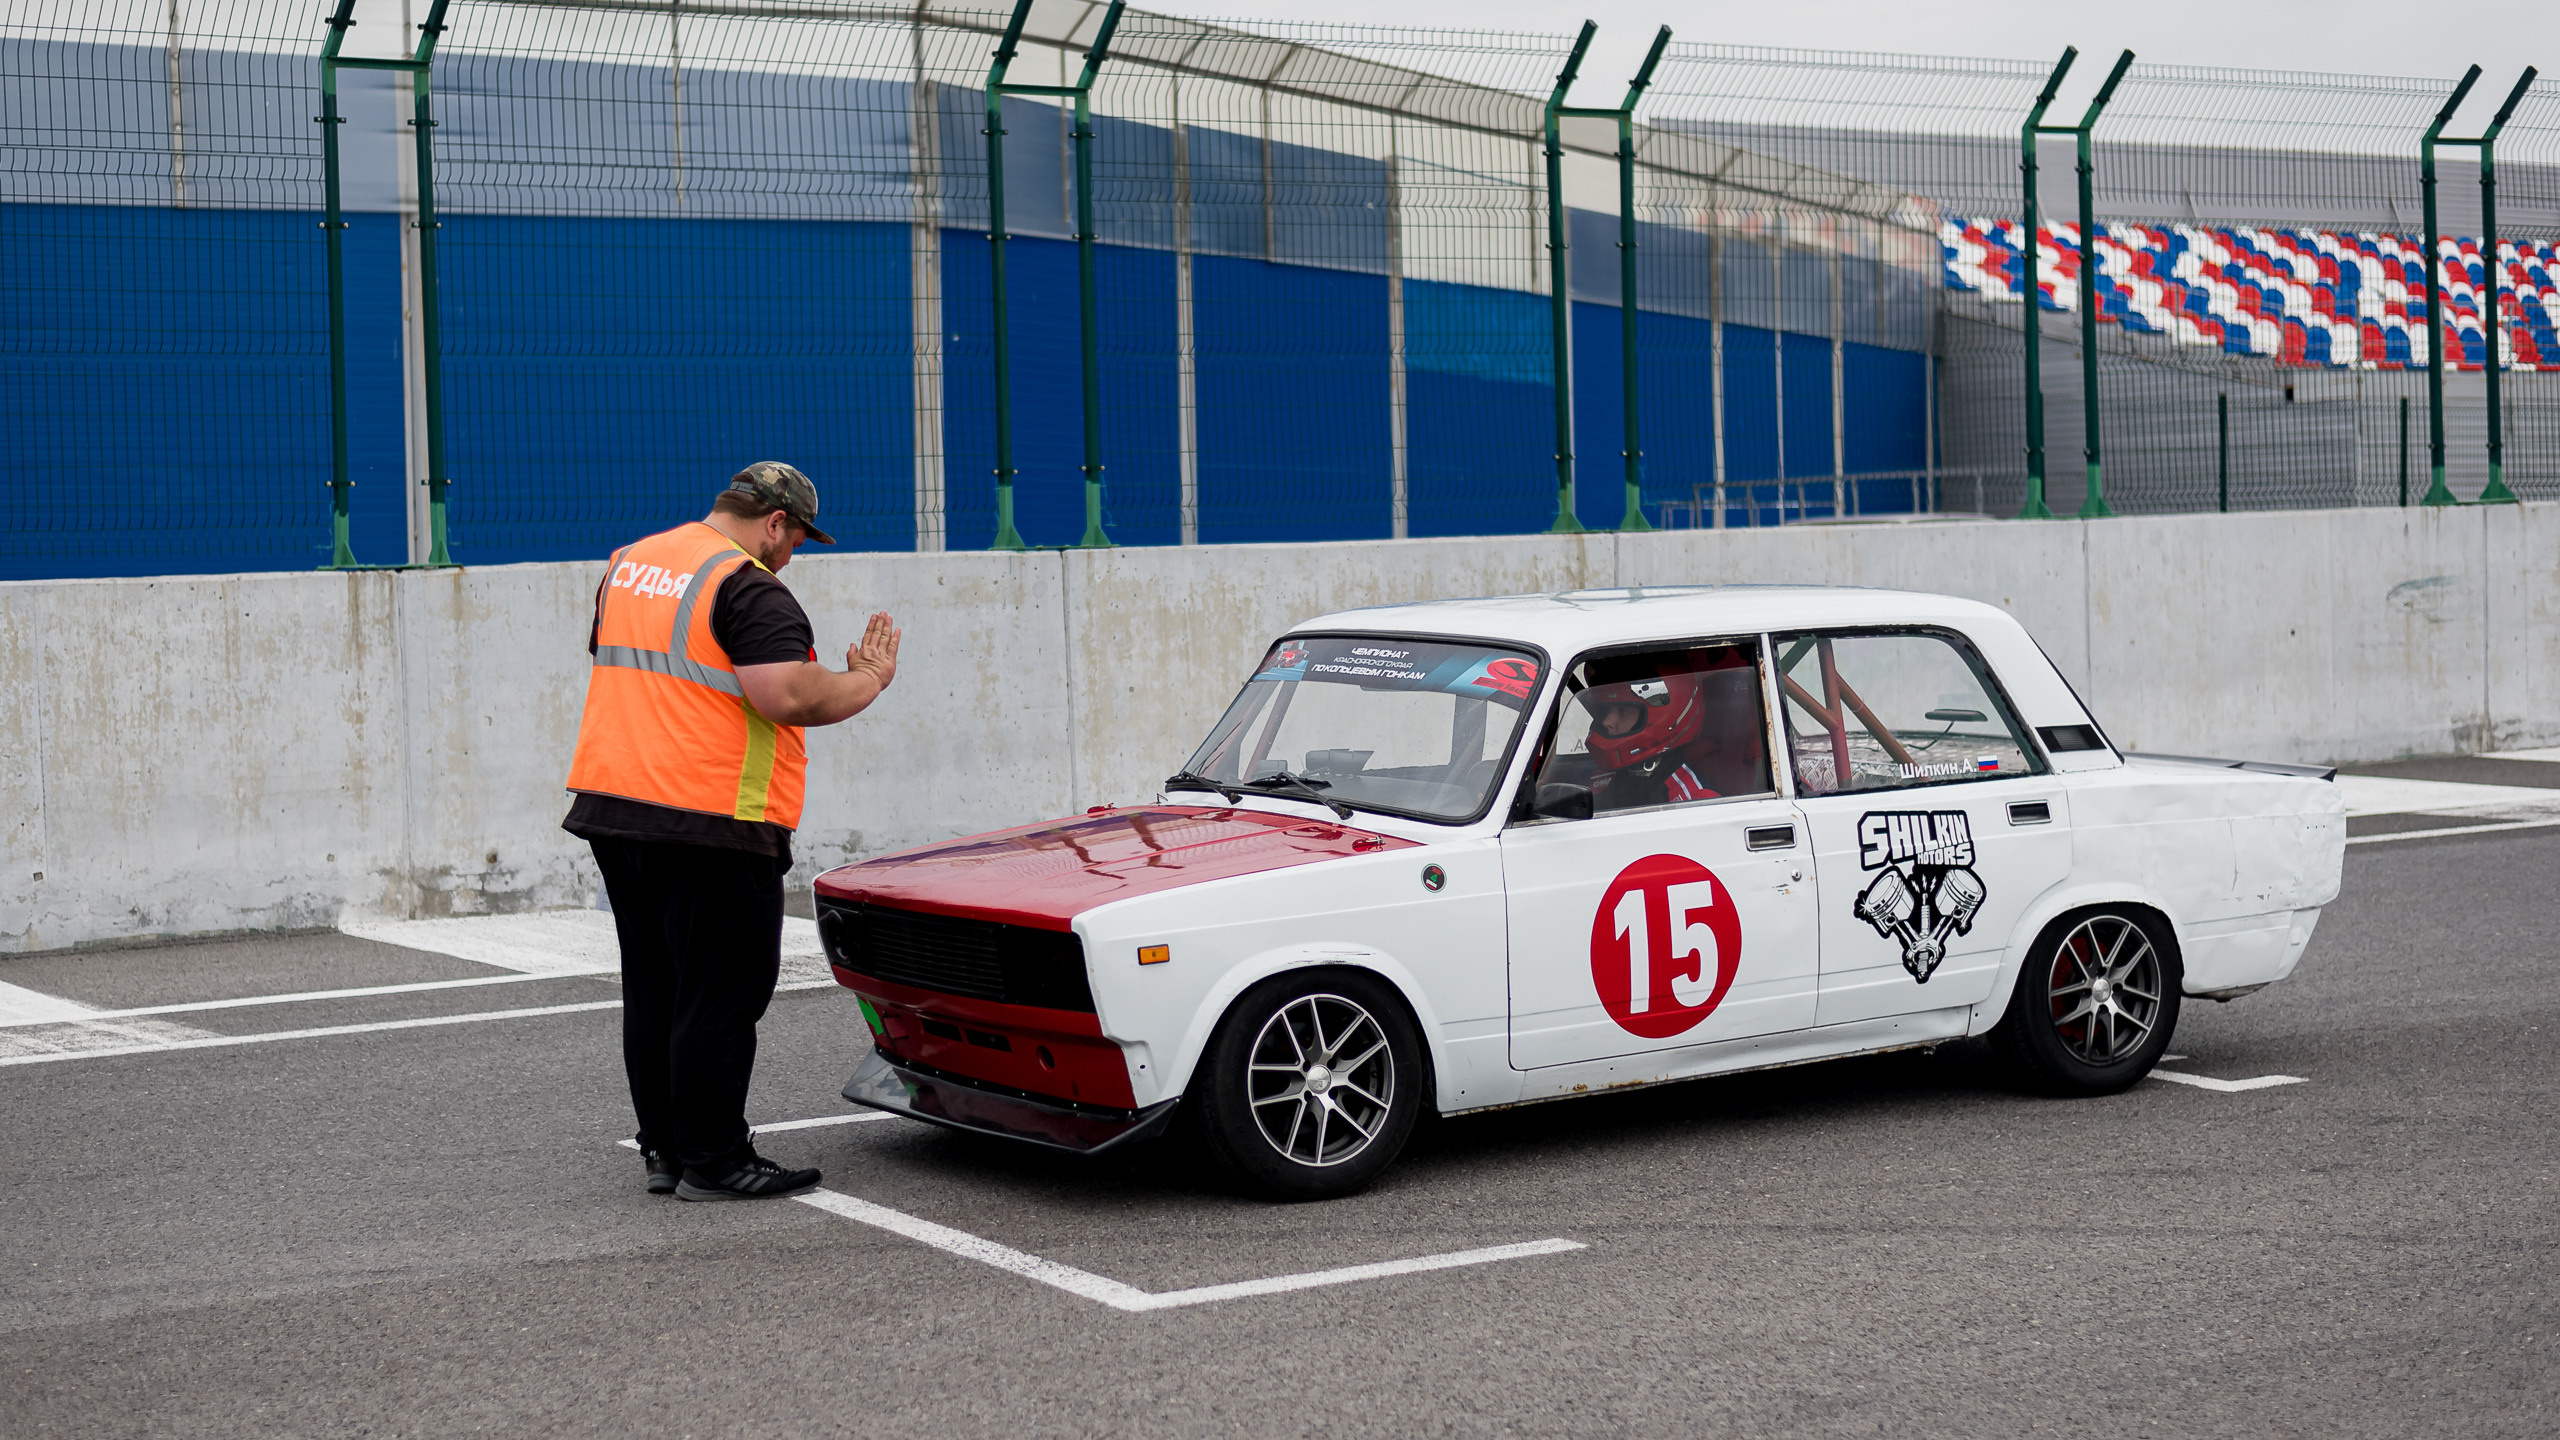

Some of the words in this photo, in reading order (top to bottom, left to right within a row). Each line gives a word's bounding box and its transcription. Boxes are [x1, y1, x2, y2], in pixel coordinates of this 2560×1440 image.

[611, 561, 694, 599] СУДЬЯ
[1351, 647, 1410, 659] ЧЕМПИОНАТ
[1311, 664, 1324, 672] ПО
[1323, 664, 1381, 677] КОЛЬЦЕВЫМ
[1380, 669, 1426, 680] ГОНКАМ
[1861, 814, 1969, 866] SHILKIN
[1917, 842, 1972, 866] MOTORS
[1613, 880, 1719, 1014] 15
